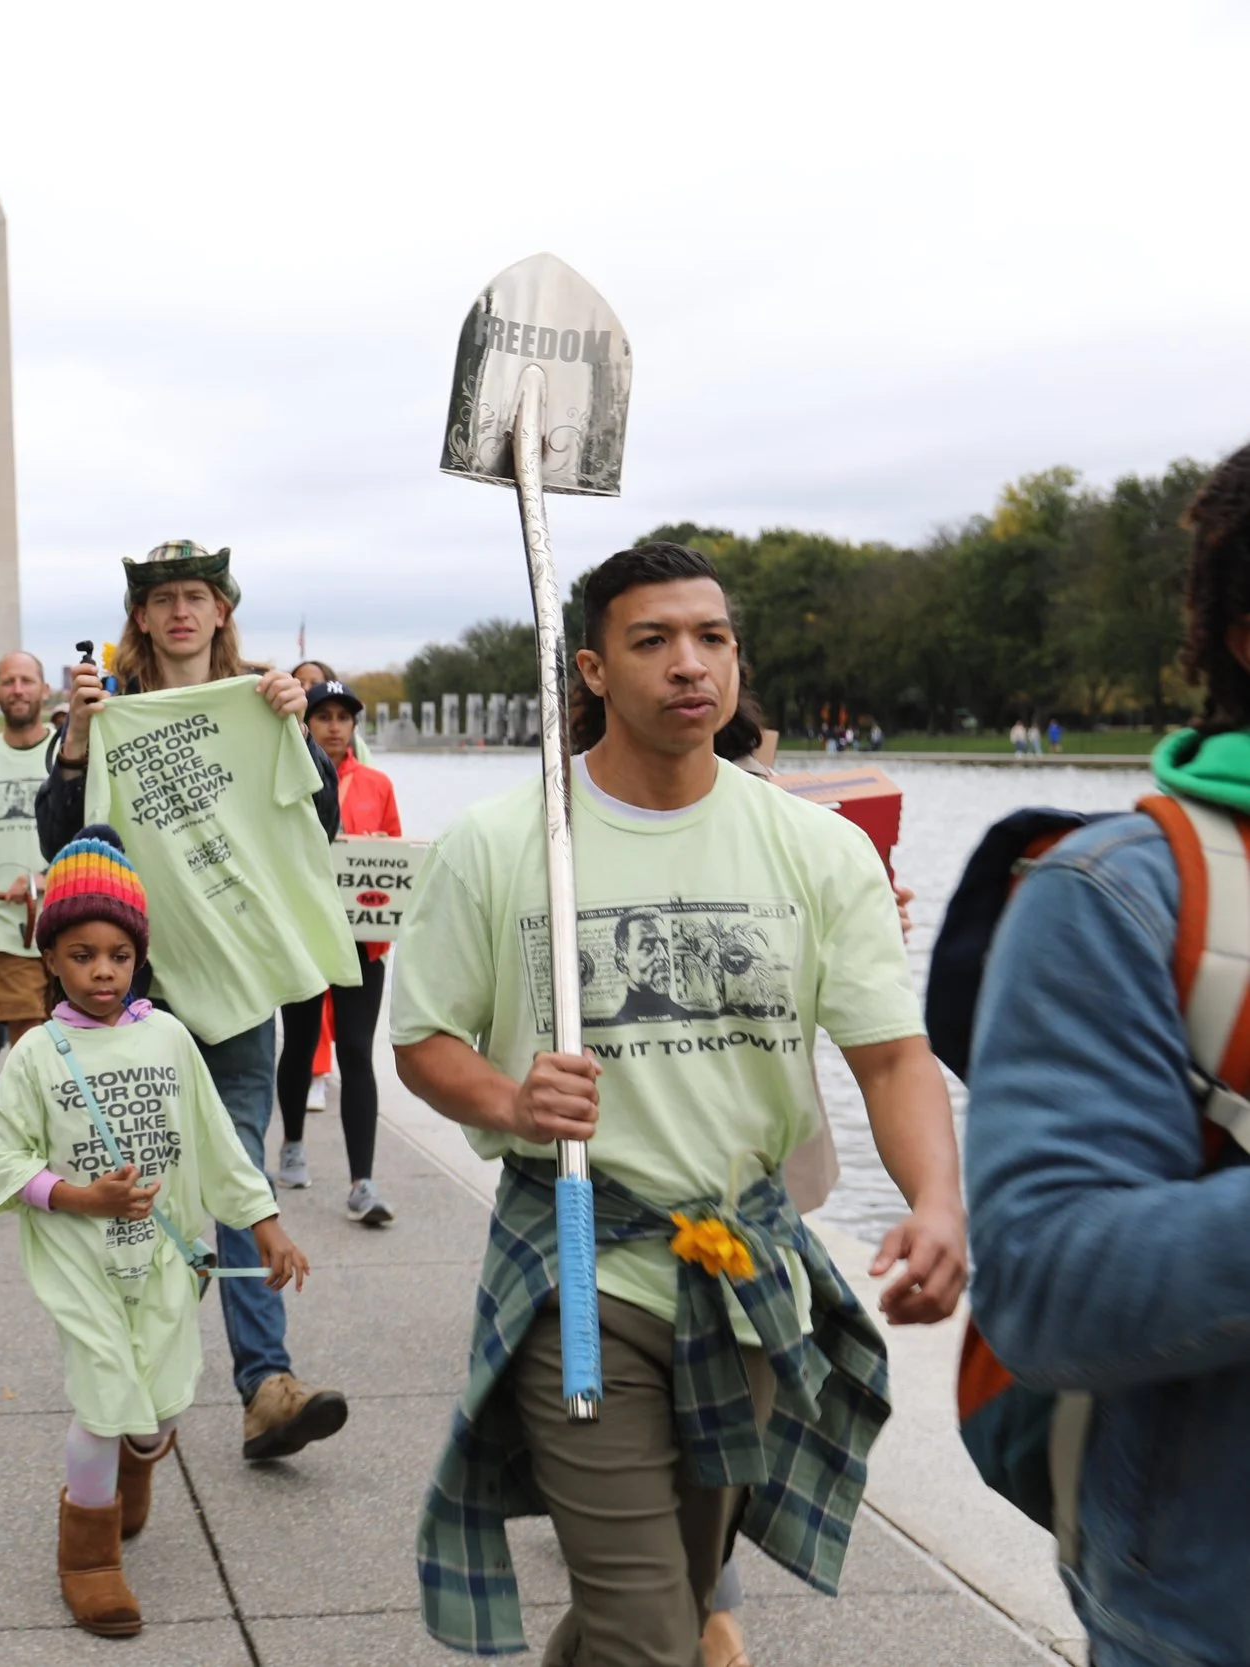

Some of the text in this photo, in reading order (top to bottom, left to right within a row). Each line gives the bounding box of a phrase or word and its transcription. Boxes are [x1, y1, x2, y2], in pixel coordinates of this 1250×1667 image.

[475, 313, 612, 363] FREEDOM
[105, 713, 210, 765] GROWING
[108, 723, 220, 778] YOUR OWN
[136, 746, 196, 779] FOOD
[138, 755, 205, 793] IS LIKE
[131, 763, 223, 813] PRINTING
[131, 771, 235, 827] YOUR OWN
[346, 857, 409, 869] TAKING
[336, 873, 414, 890] BACK
[360, 894, 387, 904] MY
[629, 1041, 651, 1058] IT
[658, 1039, 693, 1055] TO
[697, 1030, 776, 1053] KNOW
[782, 1037, 802, 1054] IT
[56, 1082, 180, 1112] YOUR OWN
[119, 1113, 167, 1134] LIKE
[72, 1130, 181, 1157] PRNTING
[68, 1149, 136, 1172] YOUR
[106, 1219, 155, 1238] MARCH
